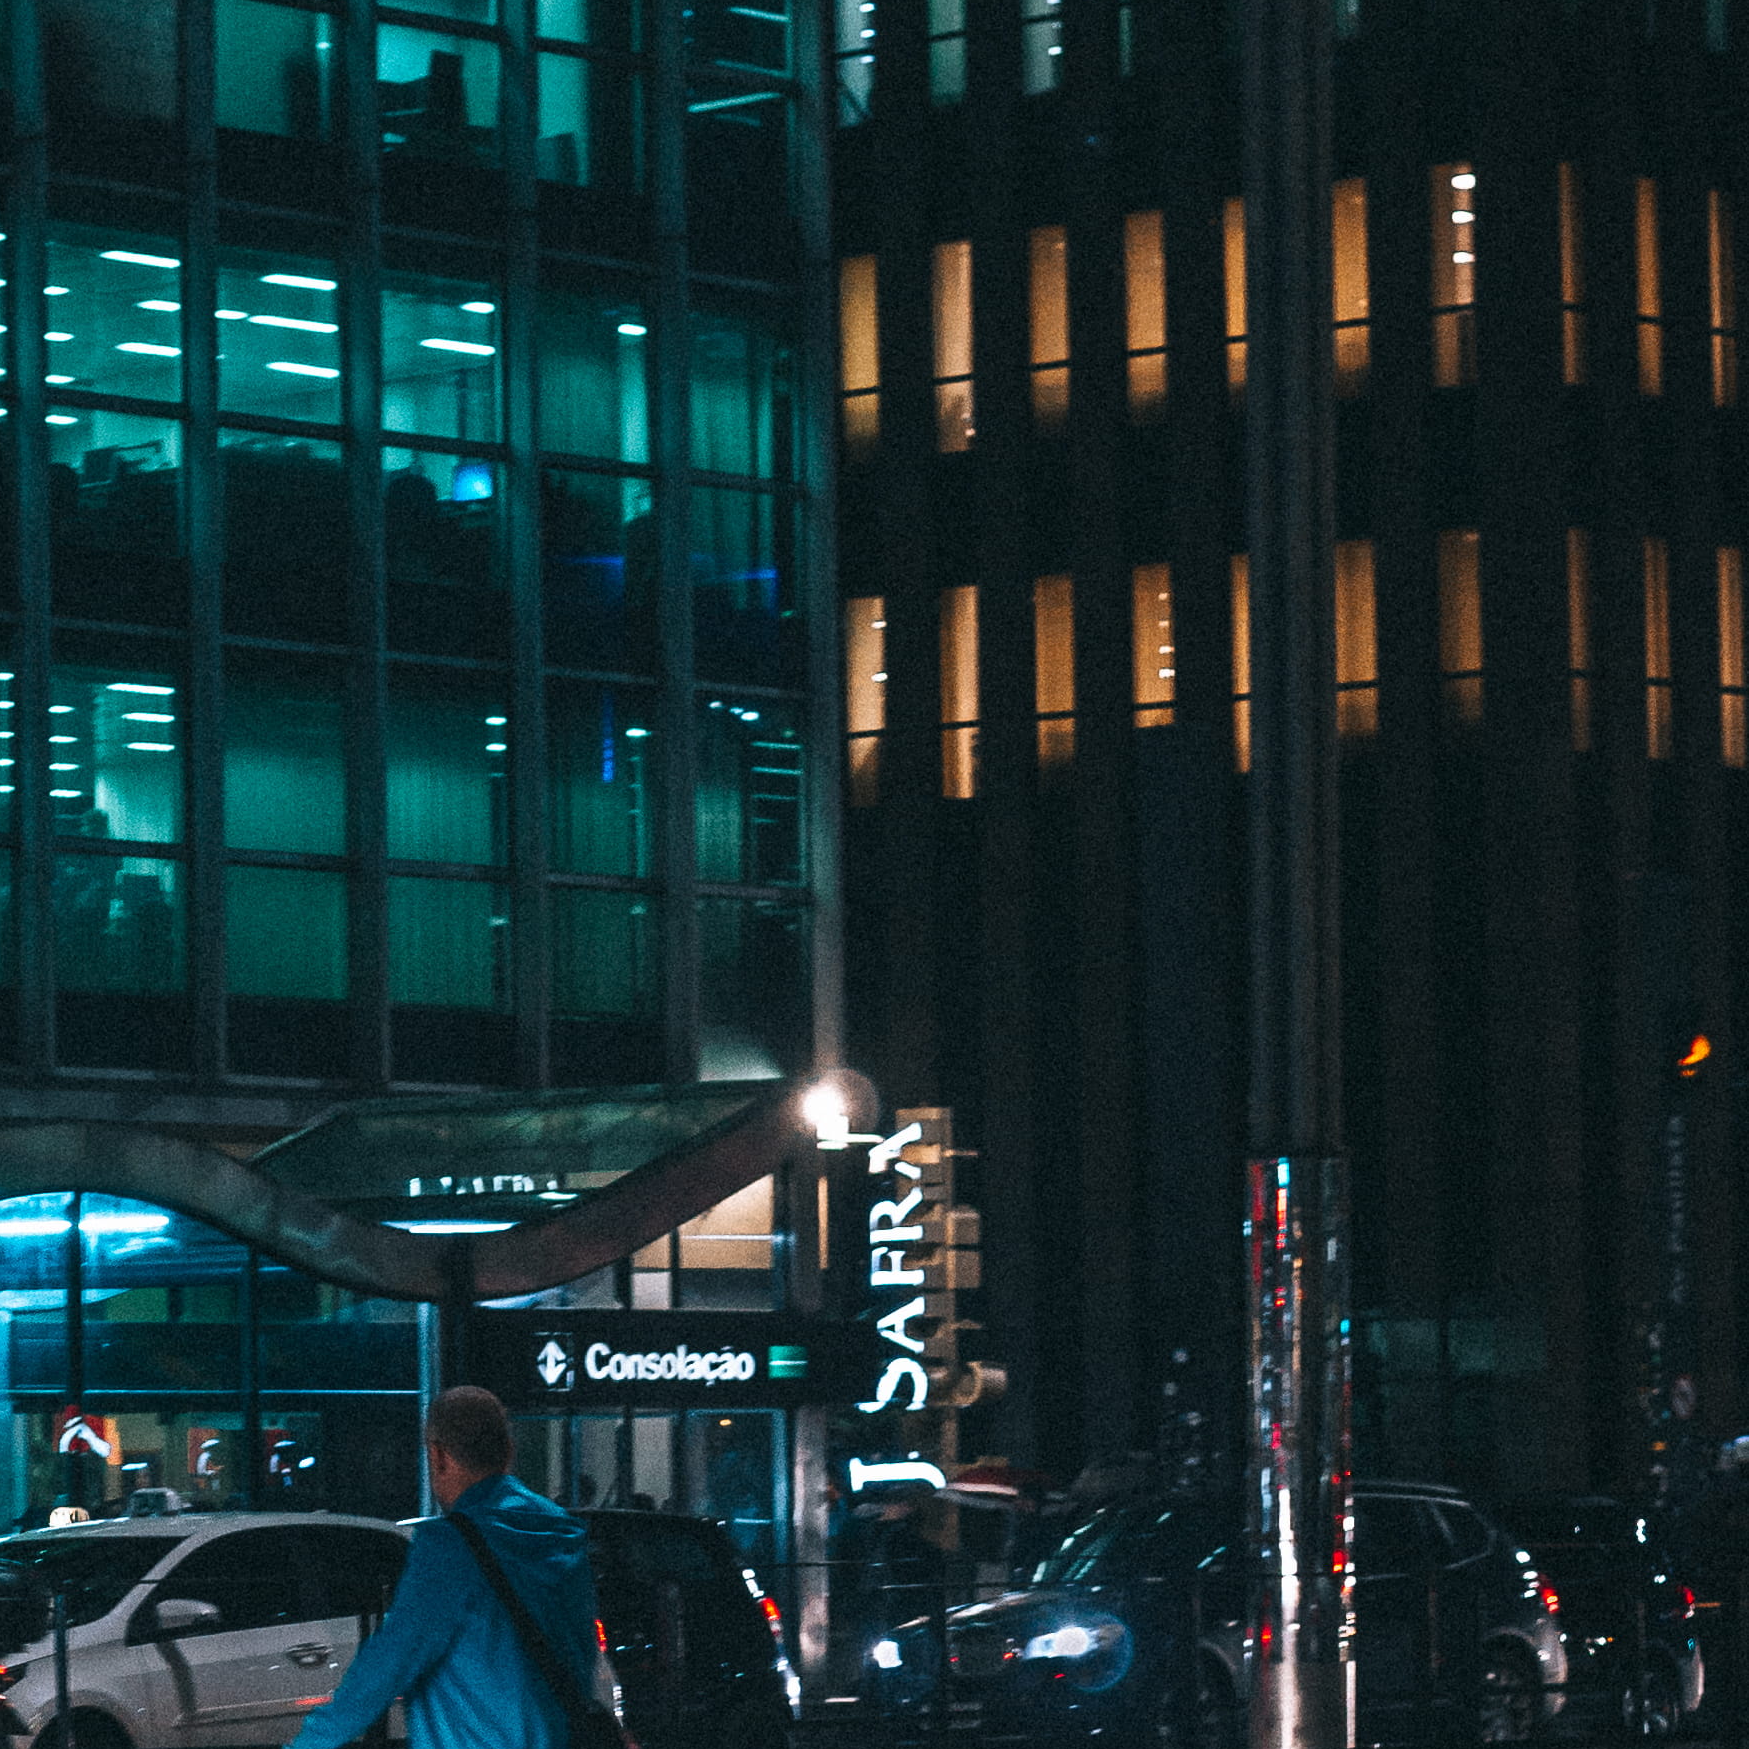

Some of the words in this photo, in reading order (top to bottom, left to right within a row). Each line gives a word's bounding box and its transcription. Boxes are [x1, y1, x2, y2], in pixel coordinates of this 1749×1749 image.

[857, 1123, 928, 1412] SAFRA
[585, 1343, 755, 1386] Consolação
[849, 1451, 947, 1492] J.
